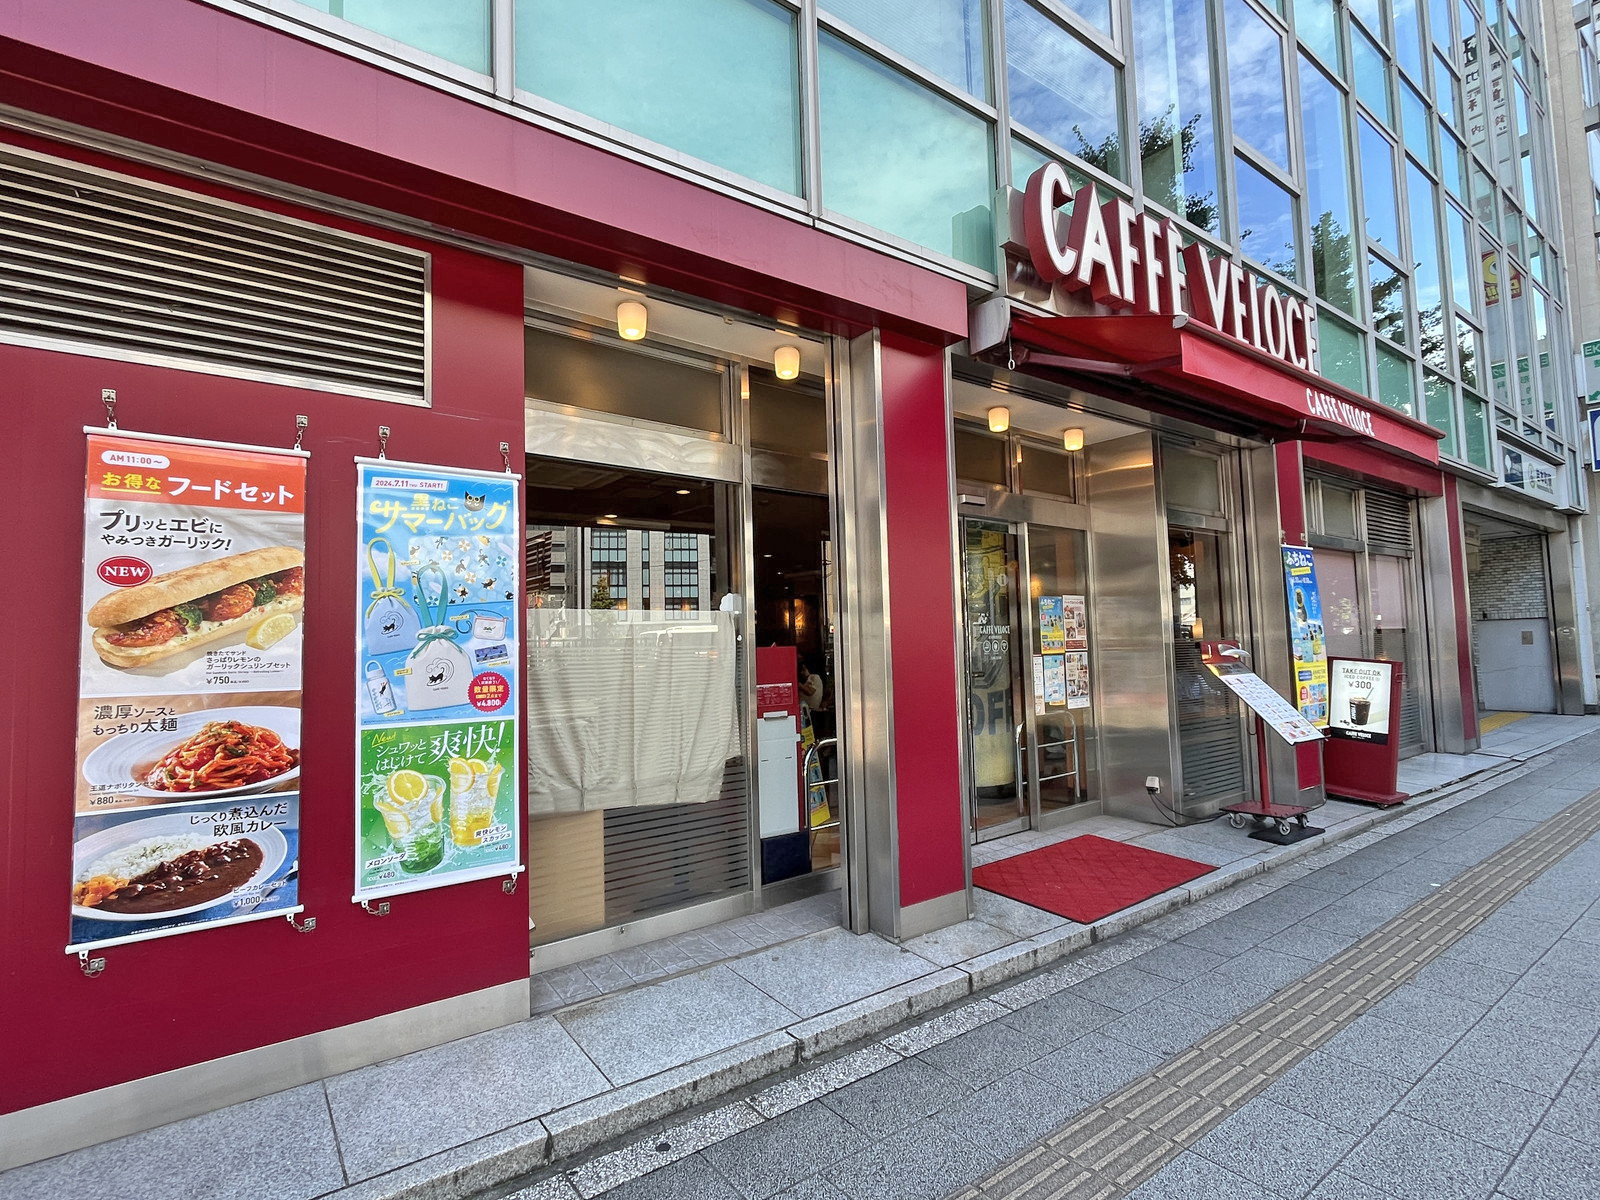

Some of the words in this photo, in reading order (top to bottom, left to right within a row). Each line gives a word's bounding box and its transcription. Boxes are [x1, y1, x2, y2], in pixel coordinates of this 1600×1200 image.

[1193, 241, 1321, 377] VELOCE
[1337, 400, 1376, 437] VELOCE
[110, 454, 124, 462] AM
[101, 472, 161, 490] お得な
[167, 476, 295, 506] フードセット
[375, 479, 409, 488] 2024.7.11
[419, 481, 444, 489] START!
[410, 493, 460, 512] 黒ねこ
[99, 509, 223, 535] プリッとエビに
[369, 499, 511, 534] サマーバッグ
[104, 565, 148, 578] NEW
[206, 662, 291, 671] ガーリックシュリンプセット
[1342, 667, 1358, 675] TAKE
[206, 676, 230, 685] ¥750
[1348, 680, 1372, 690] ¥300
[1356, 674, 1375, 682] COFFEE
[94, 704, 176, 720] 濃厚ソースと
[92, 717, 178, 736] もっちり太麺
[376, 738, 427, 758] シュワッと
[375, 752, 427, 771] はじけて
[90, 796, 114, 806] ¥880
[190, 802, 288, 825] じっくり煮込んだ
[213, 820, 287, 837] 欧風カレー
[366, 852, 407, 869] メロンソーダ
[233, 895, 261, 907] ¥1,000
